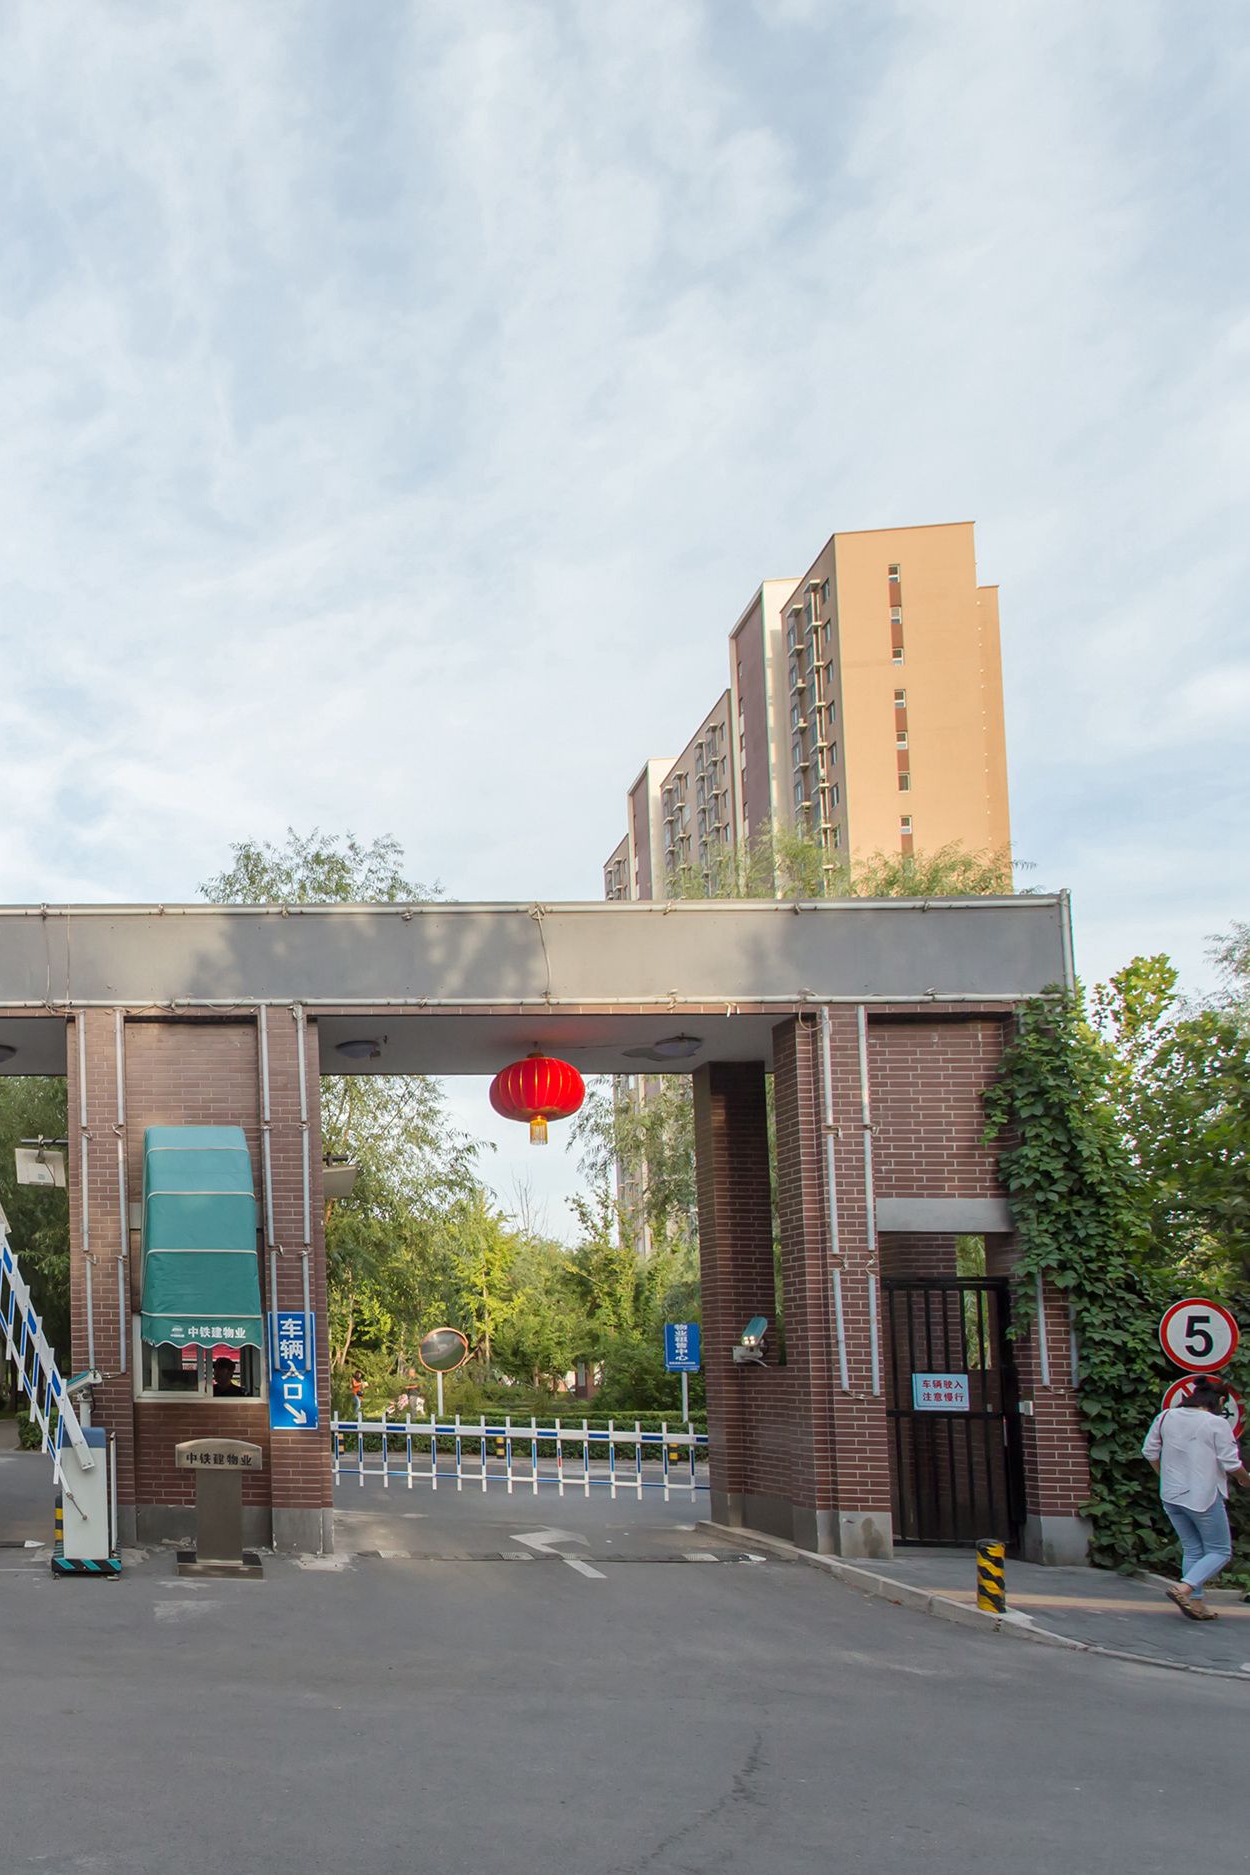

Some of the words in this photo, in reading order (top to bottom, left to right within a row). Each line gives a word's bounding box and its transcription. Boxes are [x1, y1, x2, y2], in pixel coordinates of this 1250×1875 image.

[187, 1325, 248, 1339] 中铁建物业
[1184, 1314, 1215, 1359] 5
[279, 1317, 305, 1400] 车辆入口
[921, 1379, 964, 1390] 车辆驶入
[921, 1391, 965, 1402] 注意慢行
[185, 1451, 253, 1467] 中铁建物业
